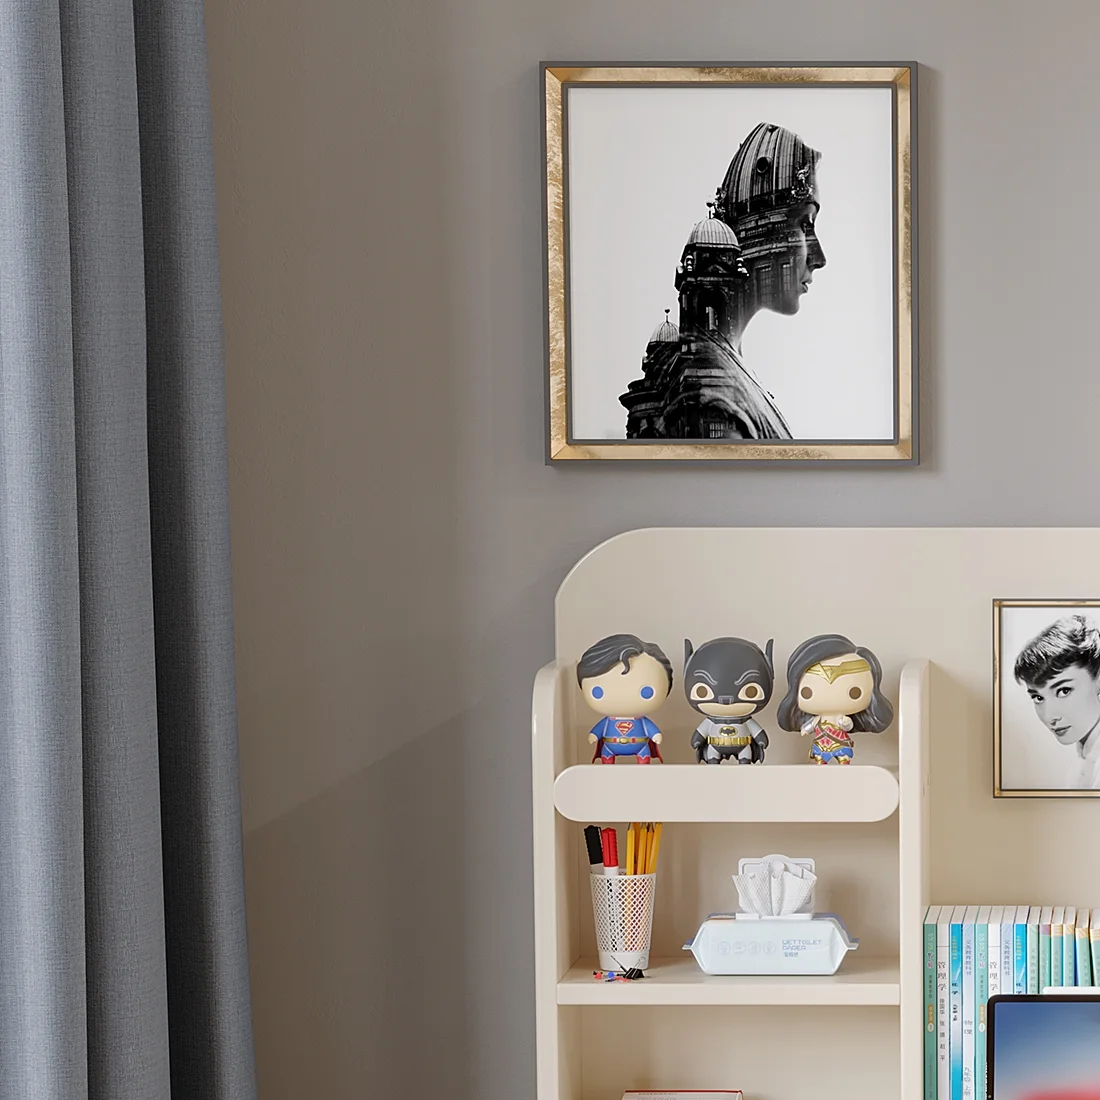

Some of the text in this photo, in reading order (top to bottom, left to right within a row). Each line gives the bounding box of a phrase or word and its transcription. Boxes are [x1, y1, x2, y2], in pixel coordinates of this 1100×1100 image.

[937, 961, 947, 992] 管理学
[989, 961, 998, 992] 管理学
